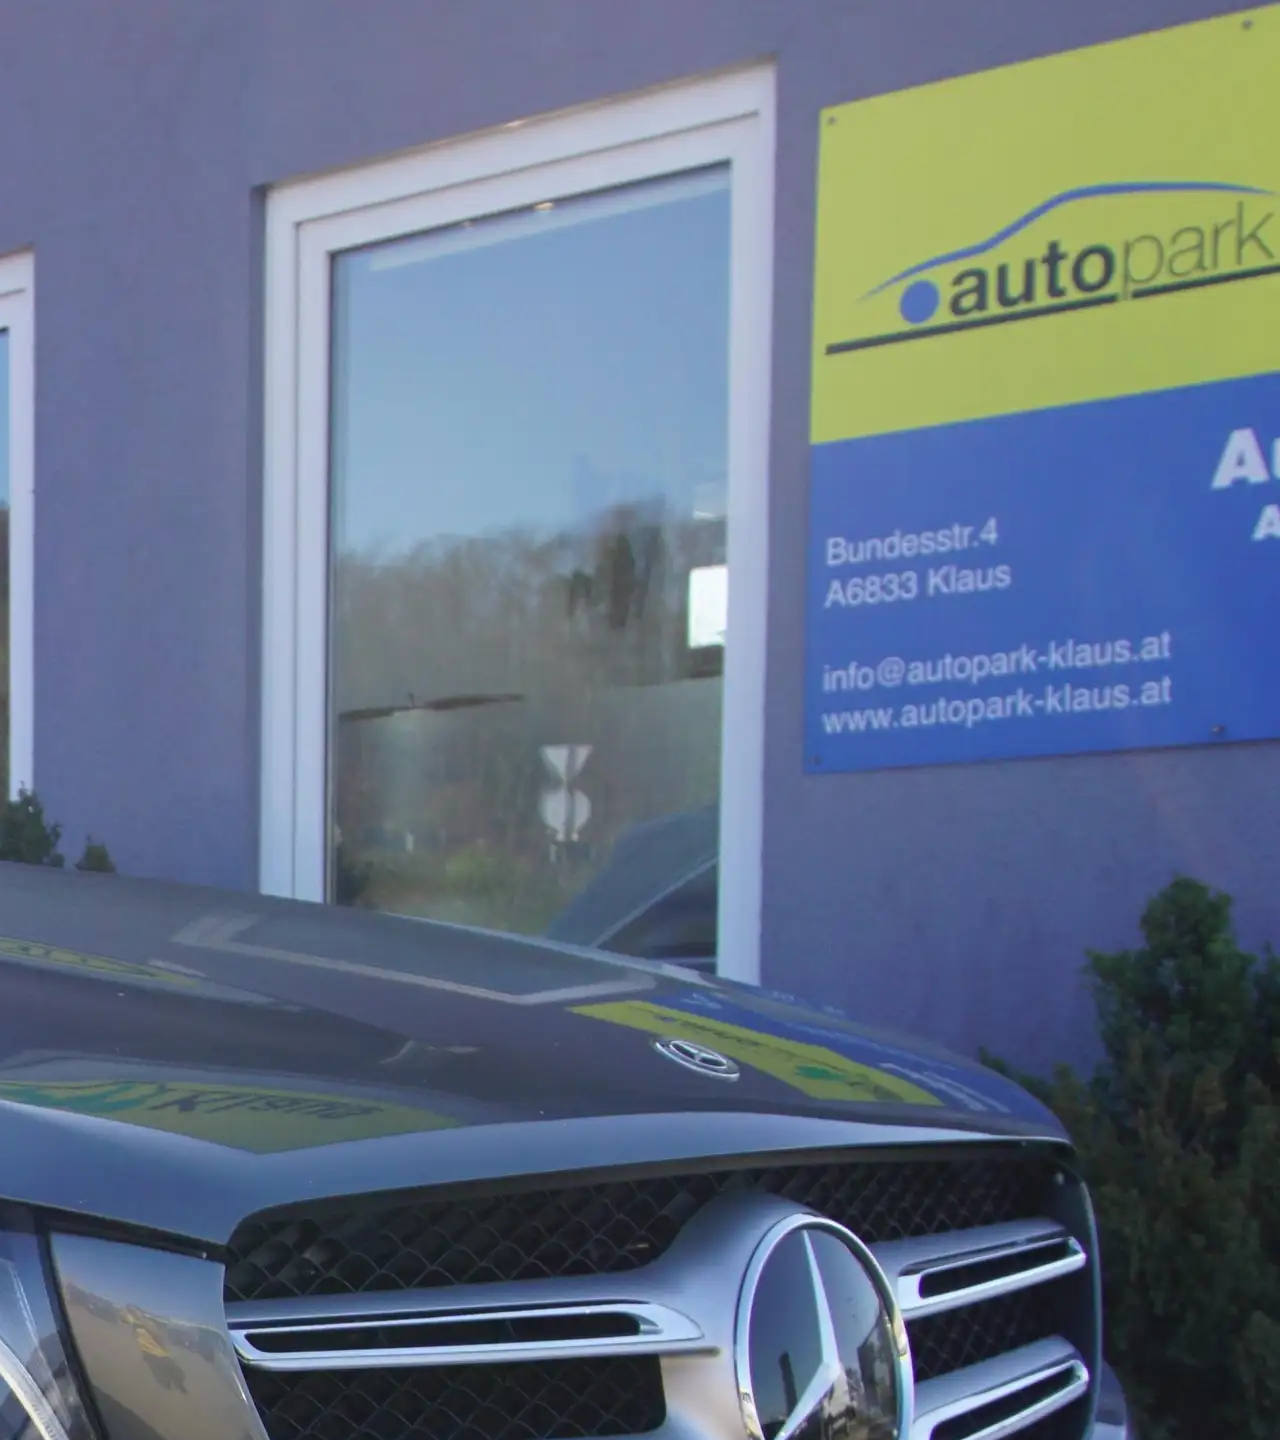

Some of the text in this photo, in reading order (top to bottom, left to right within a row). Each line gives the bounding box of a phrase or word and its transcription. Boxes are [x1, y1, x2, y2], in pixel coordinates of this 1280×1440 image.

[949, 200, 1278, 317] autopark
[1211, 425, 1280, 490] A
[824, 563, 1012, 608] A6833 Klaus
[822, 631, 1172, 692] info@autopark-klaus.at
[821, 676, 1172, 734] www.autopark-klaus.at
